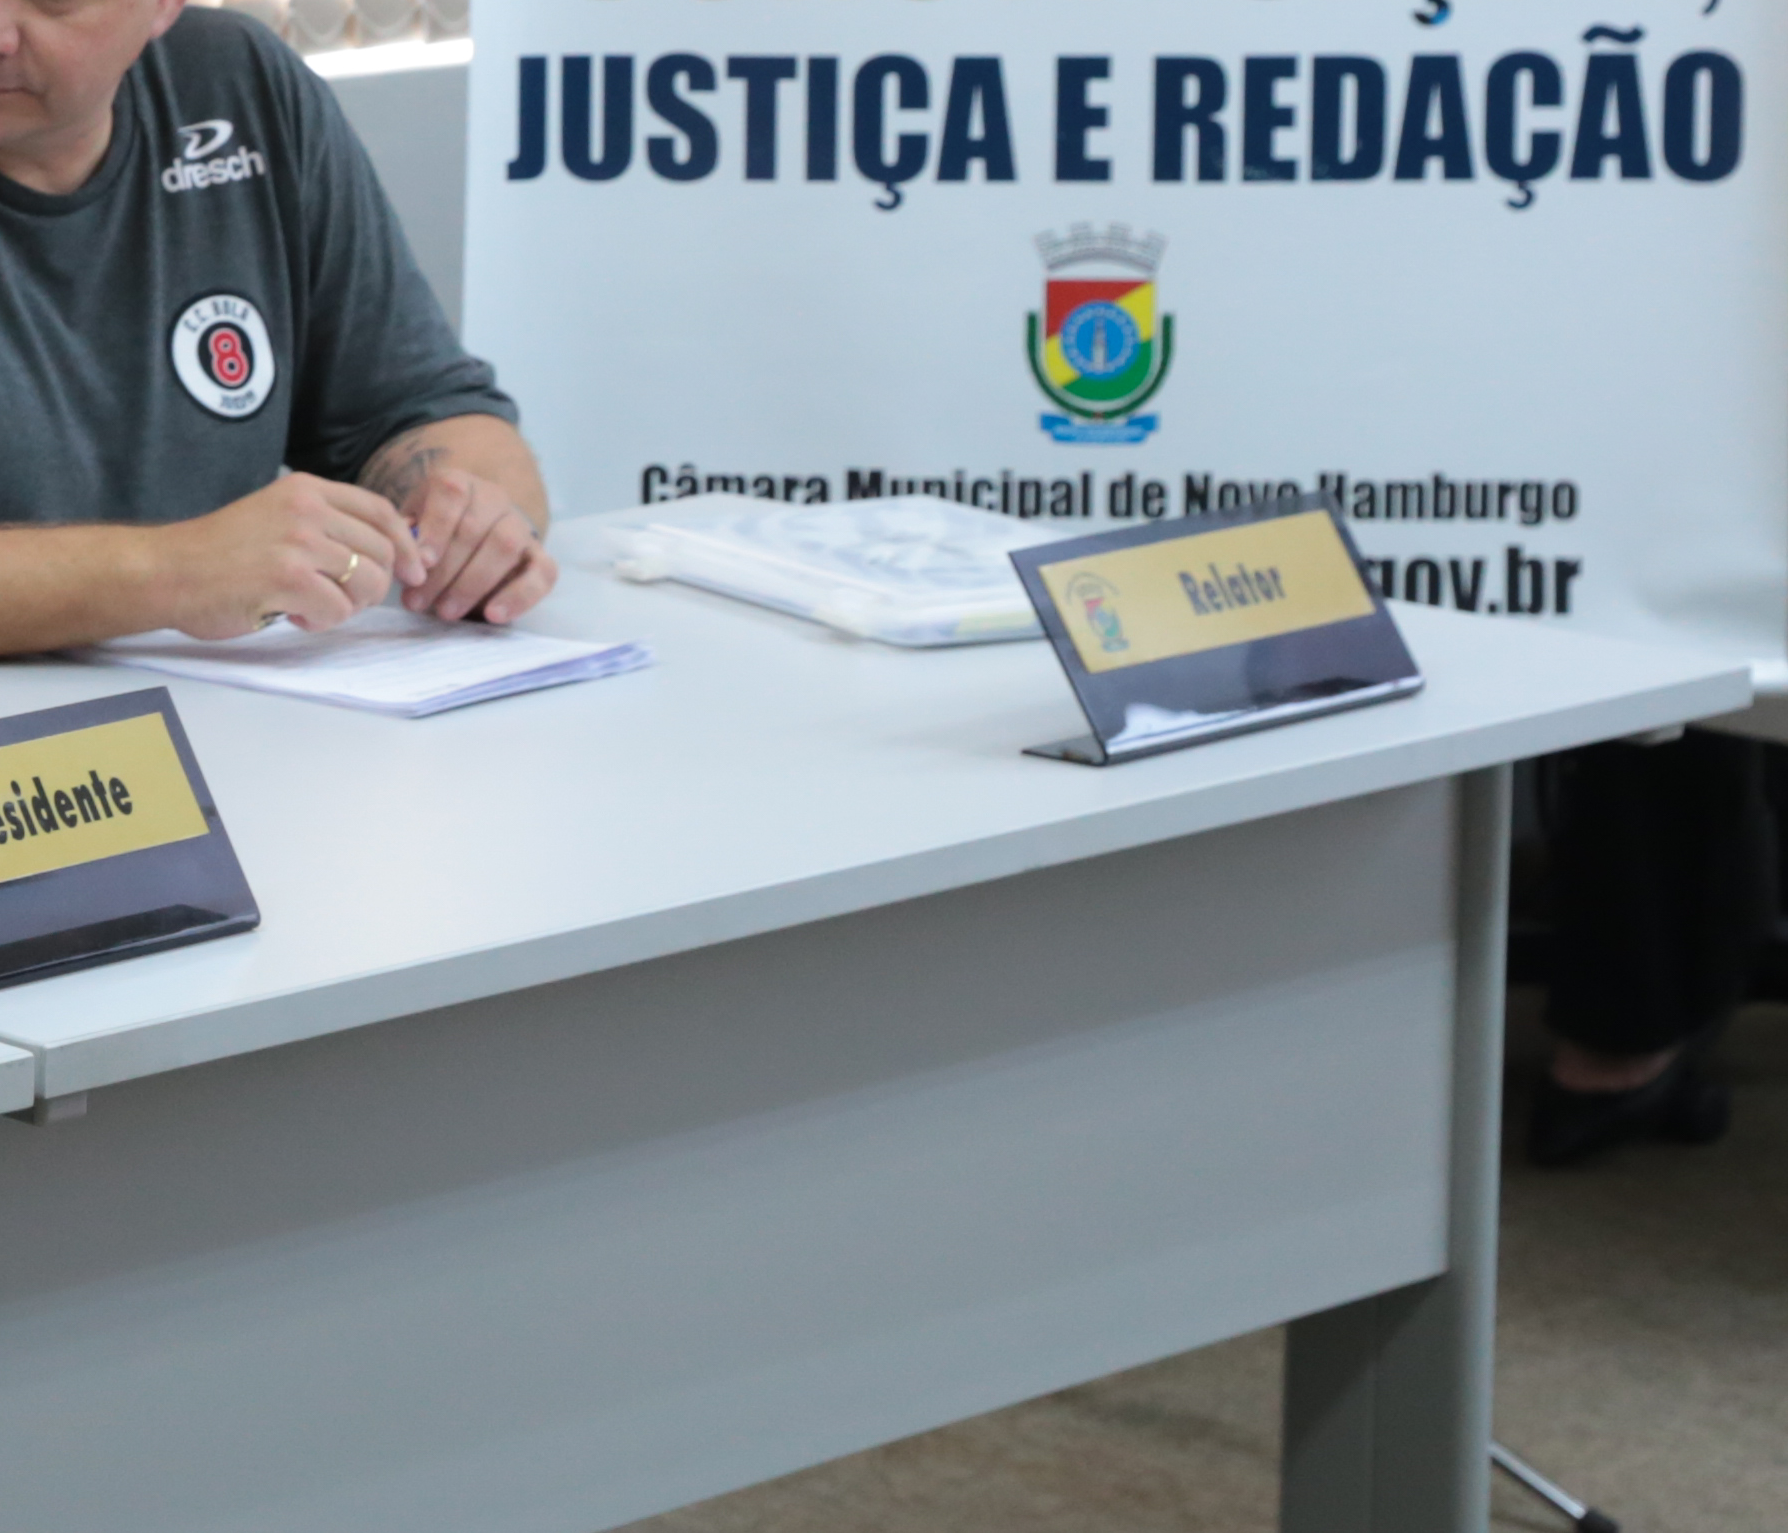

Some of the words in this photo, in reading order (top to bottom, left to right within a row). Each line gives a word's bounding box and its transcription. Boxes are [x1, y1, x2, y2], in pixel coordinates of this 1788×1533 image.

[507, 52, 1018, 212] JUSTIÇA
[1053, 54, 1113, 184] E
[1151, 24, 1745, 211] REDAÇÃO
[160, 145, 265, 194] dresch
[641, 463, 829, 505] Câmara
[846, 469, 1092, 520] Municipal
[1109, 472, 1168, 519] de
[1178, 563, 1286, 617] Relator
